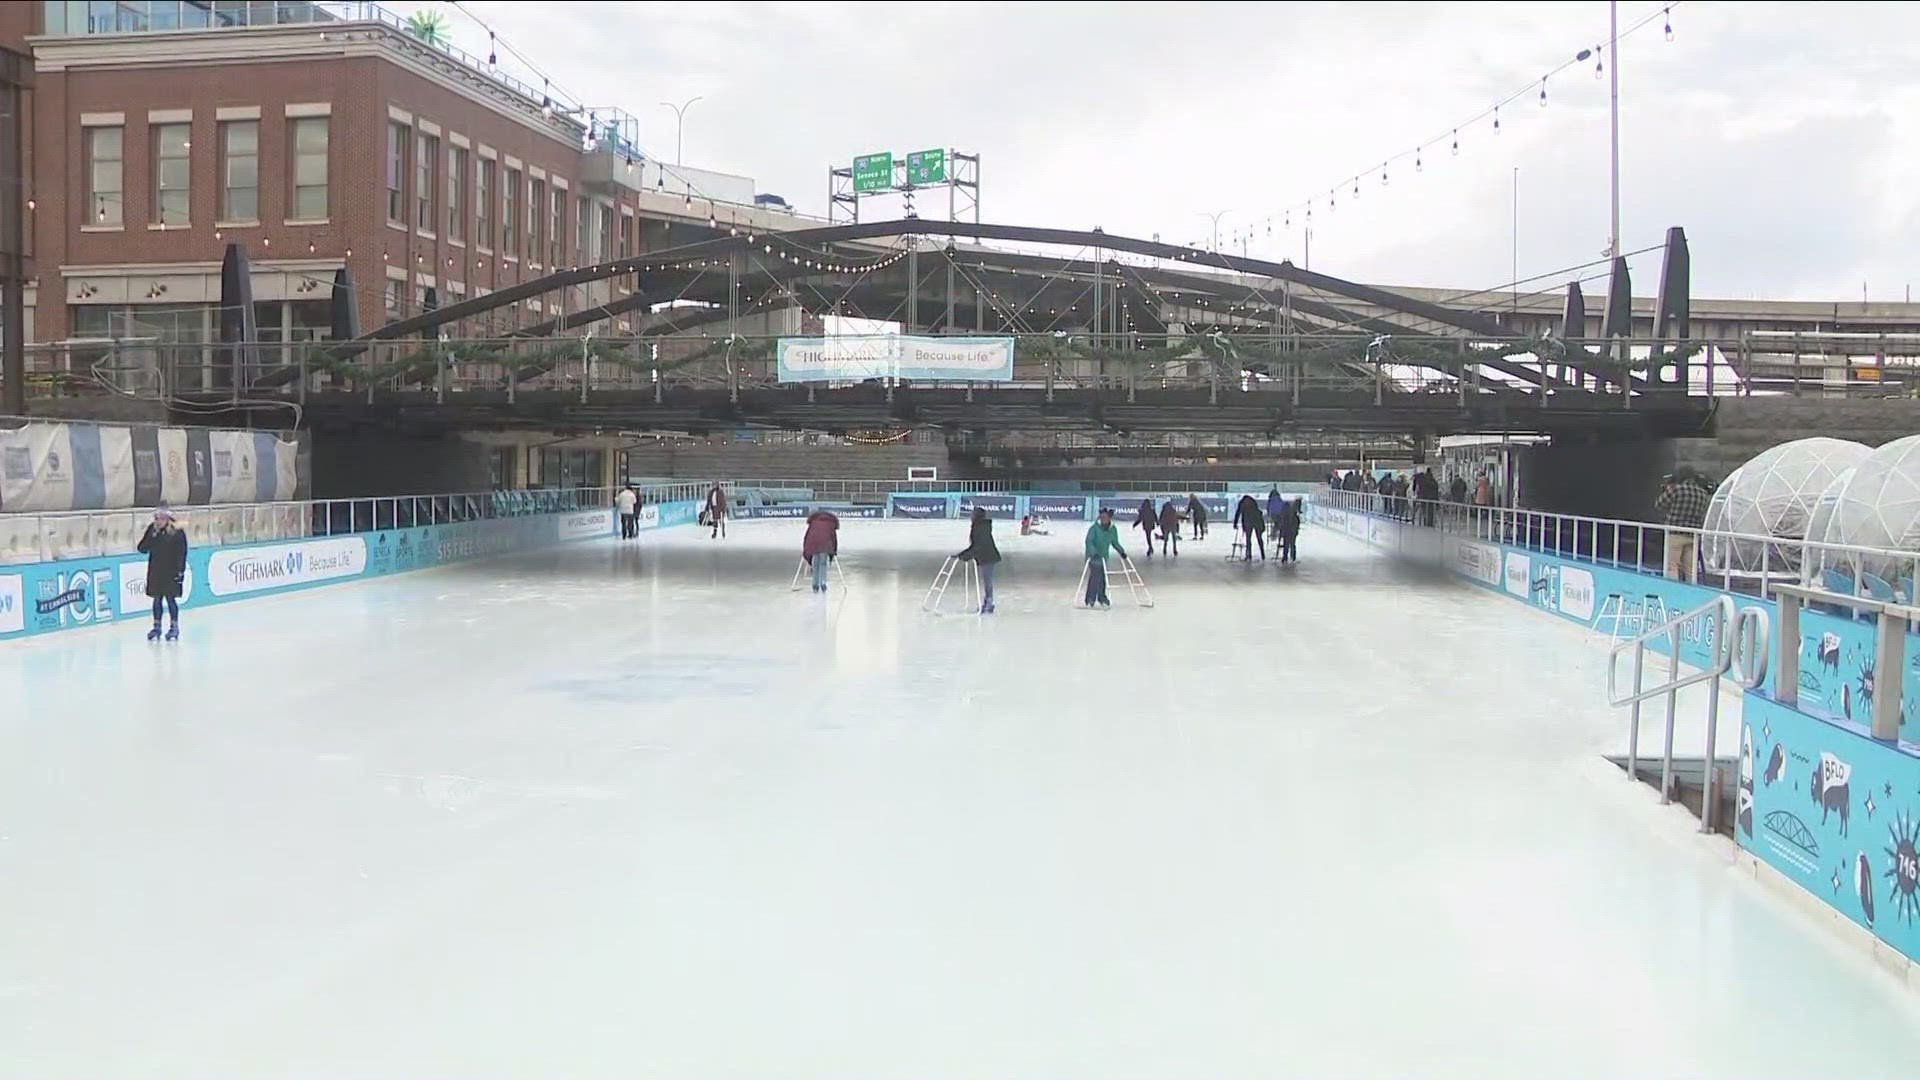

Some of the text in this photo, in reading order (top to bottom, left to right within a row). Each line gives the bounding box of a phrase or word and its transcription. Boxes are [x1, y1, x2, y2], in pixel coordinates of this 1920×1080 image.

[857, 169, 888, 181] Seneca St
[915, 349, 965, 361] Because
[897, 504, 931, 513] HIGHMARK
[1032, 504, 1069, 513] HIGHMARK
[229, 557, 285, 584] HIGHMARK
[309, 555, 337, 572] Because
[57, 567, 113, 628] ICE
[1825, 761, 1845, 782] BFLO
[1899, 853, 1917, 880] 716
